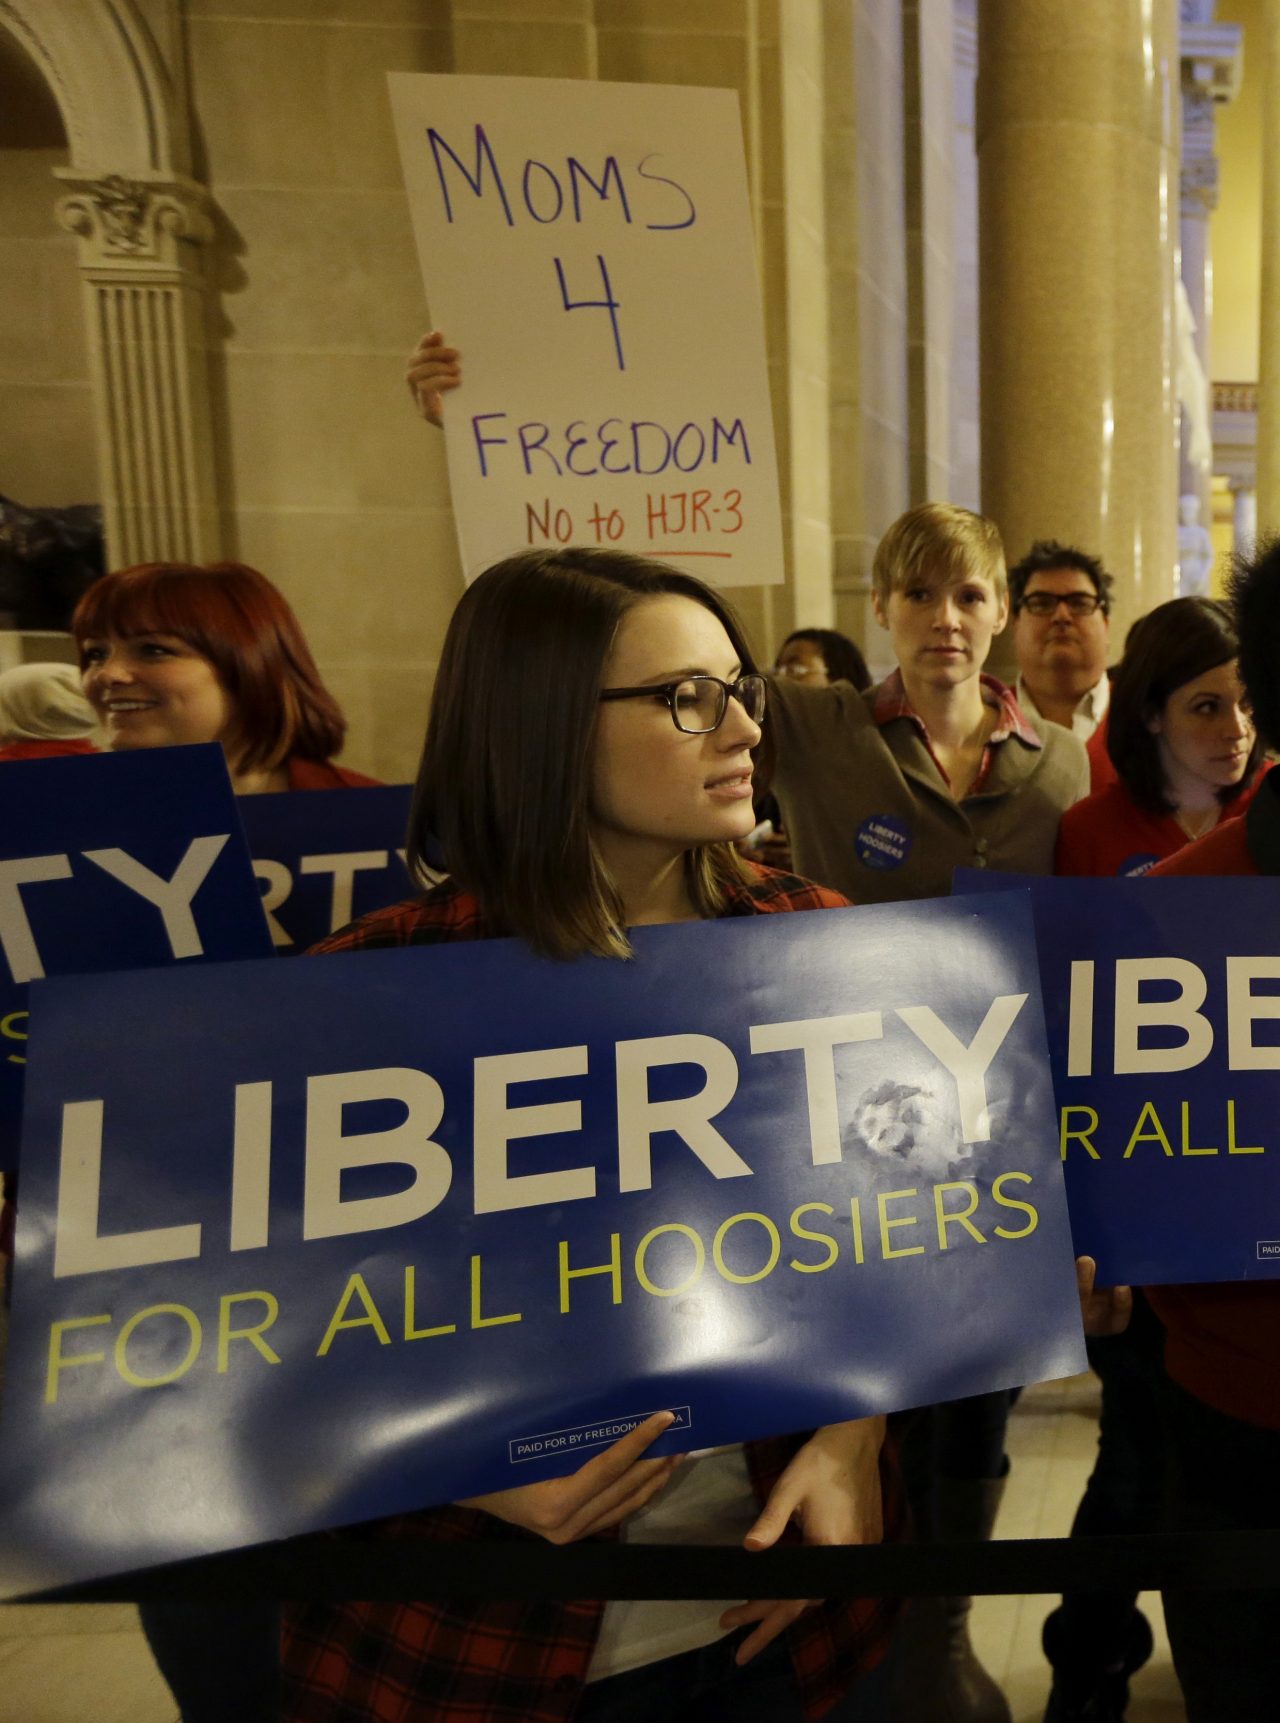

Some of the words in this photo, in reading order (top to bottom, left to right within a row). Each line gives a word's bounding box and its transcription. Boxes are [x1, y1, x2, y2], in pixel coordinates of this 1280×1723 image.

[426, 123, 696, 230] MOMS
[553, 254, 626, 371] 4
[472, 412, 752, 477] FREEDOM
[588, 502, 625, 543] to
[646, 489, 744, 540] HJR-3
[53, 992, 1029, 1280] LIBERTY
[1123, 1099, 1265, 1158] ALL
[1262, 1246, 1280, 1254] PAID
[44, 1289, 282, 1402] FOR
[315, 1254, 523, 1357] ALL
[557, 1170, 1040, 1314] HOOSIERS
[517, 1442, 543, 1455] PAID
[544, 1437, 567, 1450] FOR
[569, 1433, 583, 1445] BY
[585, 1421, 638, 1441] FREEDOM
